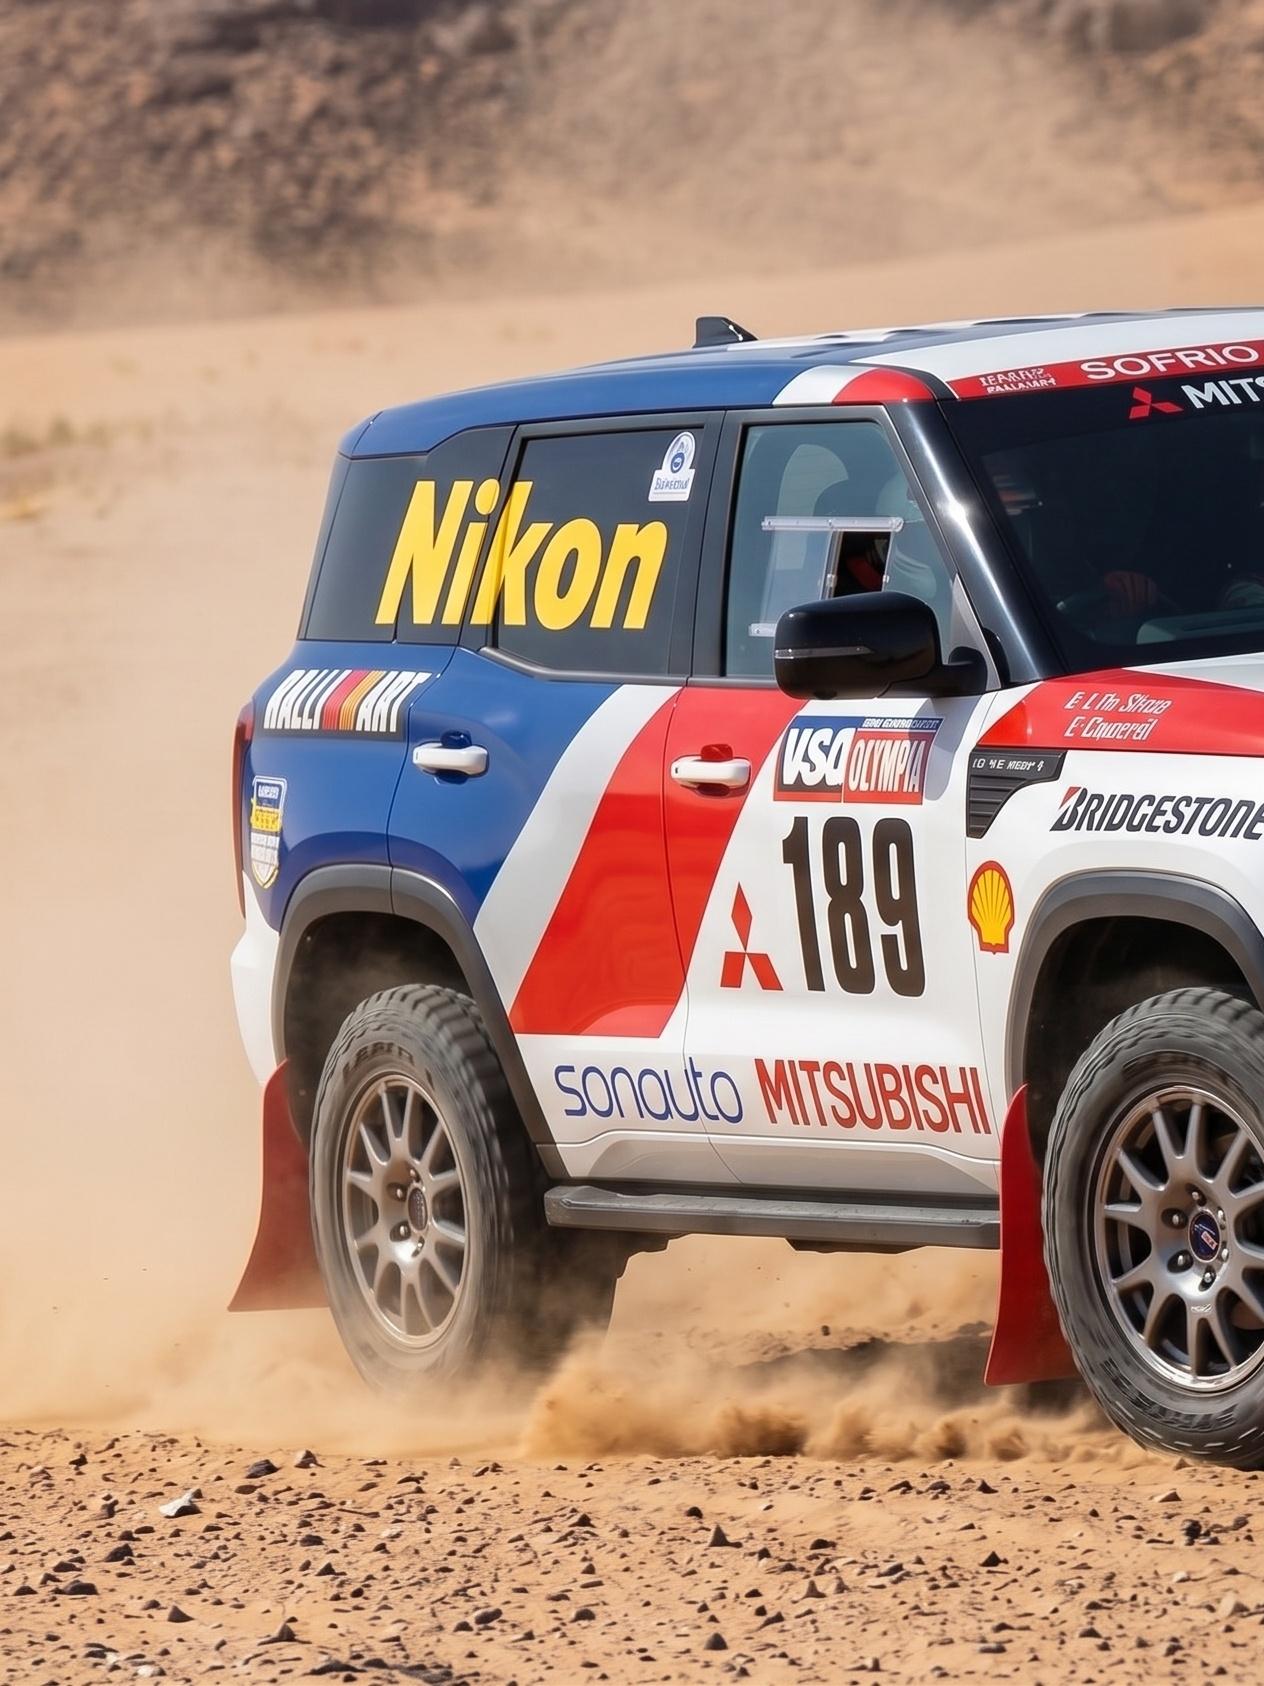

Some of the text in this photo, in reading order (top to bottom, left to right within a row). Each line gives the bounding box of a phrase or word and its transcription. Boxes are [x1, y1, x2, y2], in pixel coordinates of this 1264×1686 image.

[1080, 345, 1258, 380] SOFRIO
[374, 477, 669, 630] Nikon
[848, 738, 926, 793] OLYMPIA
[782, 816, 925, 997] 189
[554, 1056, 992, 1135] sonauto MITSUBISHI
